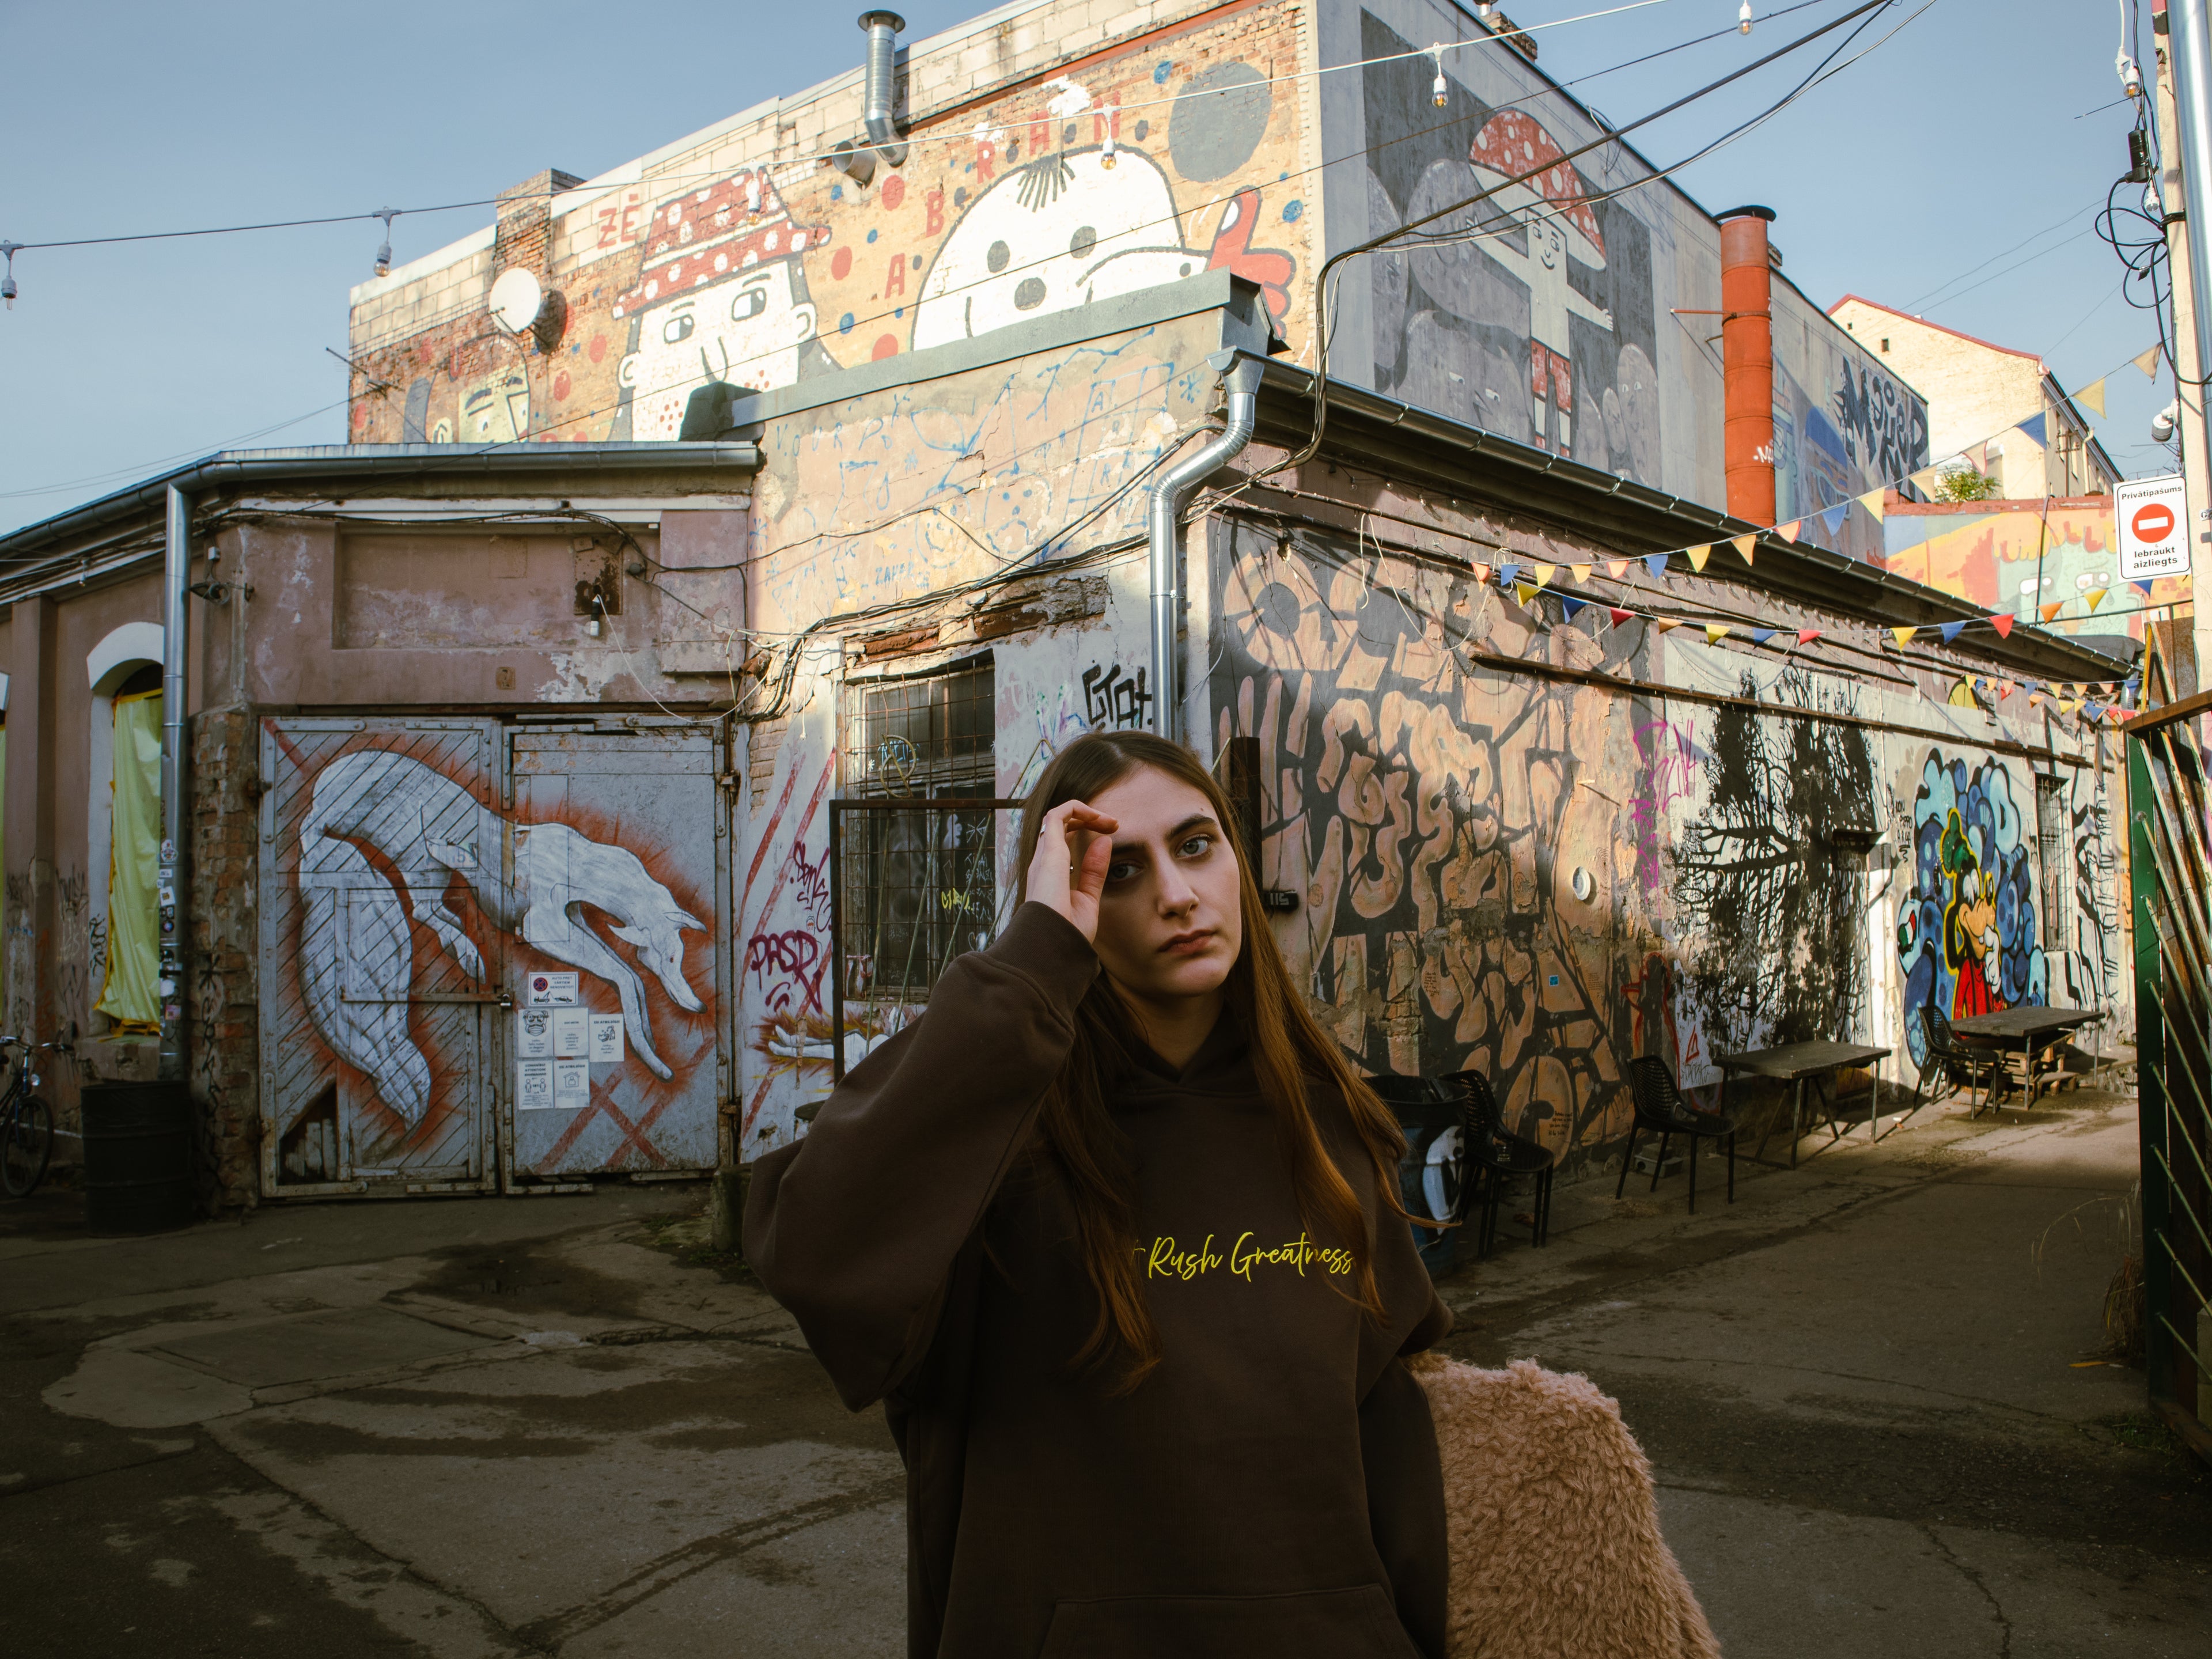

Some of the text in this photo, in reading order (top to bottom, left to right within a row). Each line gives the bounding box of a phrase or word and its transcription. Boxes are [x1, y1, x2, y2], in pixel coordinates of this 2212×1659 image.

[2121, 486, 2183, 501] Privātīpašums
[2134, 546, 2176, 559] Iebraukt
[2133, 557, 2178, 569] aizliegts
[1147, 1234, 1224, 1282] Rush
[1230, 1230, 1356, 1283] Greatness
